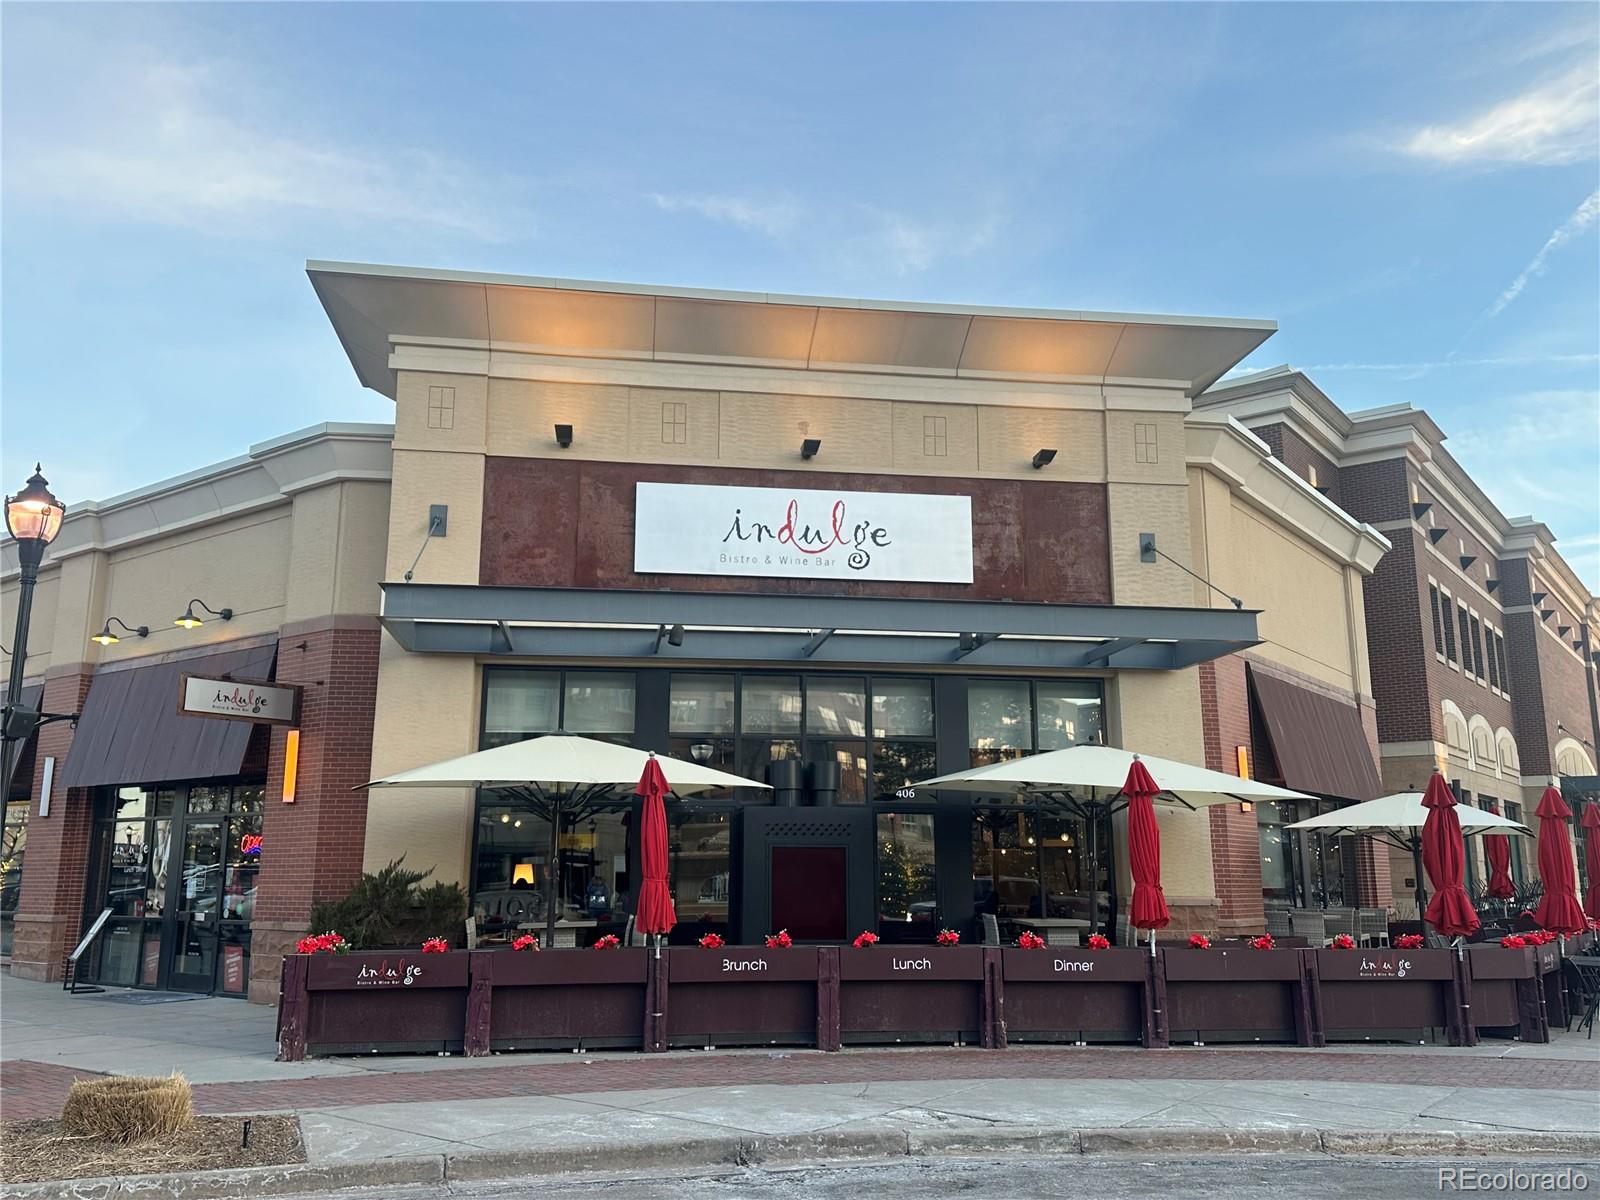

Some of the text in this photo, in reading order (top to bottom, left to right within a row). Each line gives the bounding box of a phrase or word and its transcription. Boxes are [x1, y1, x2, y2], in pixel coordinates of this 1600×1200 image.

[722, 499, 892, 570] indulge
[719, 553, 836, 567] Bistro & Wine Bar
[213, 687, 269, 713] indulge
[895, 789, 915, 798] 406
[722, 958, 768, 971] Brunch
[893, 957, 931, 970] Lunch
[1054, 959, 1094, 971] Dinner
[357, 958, 422, 985] indulge
